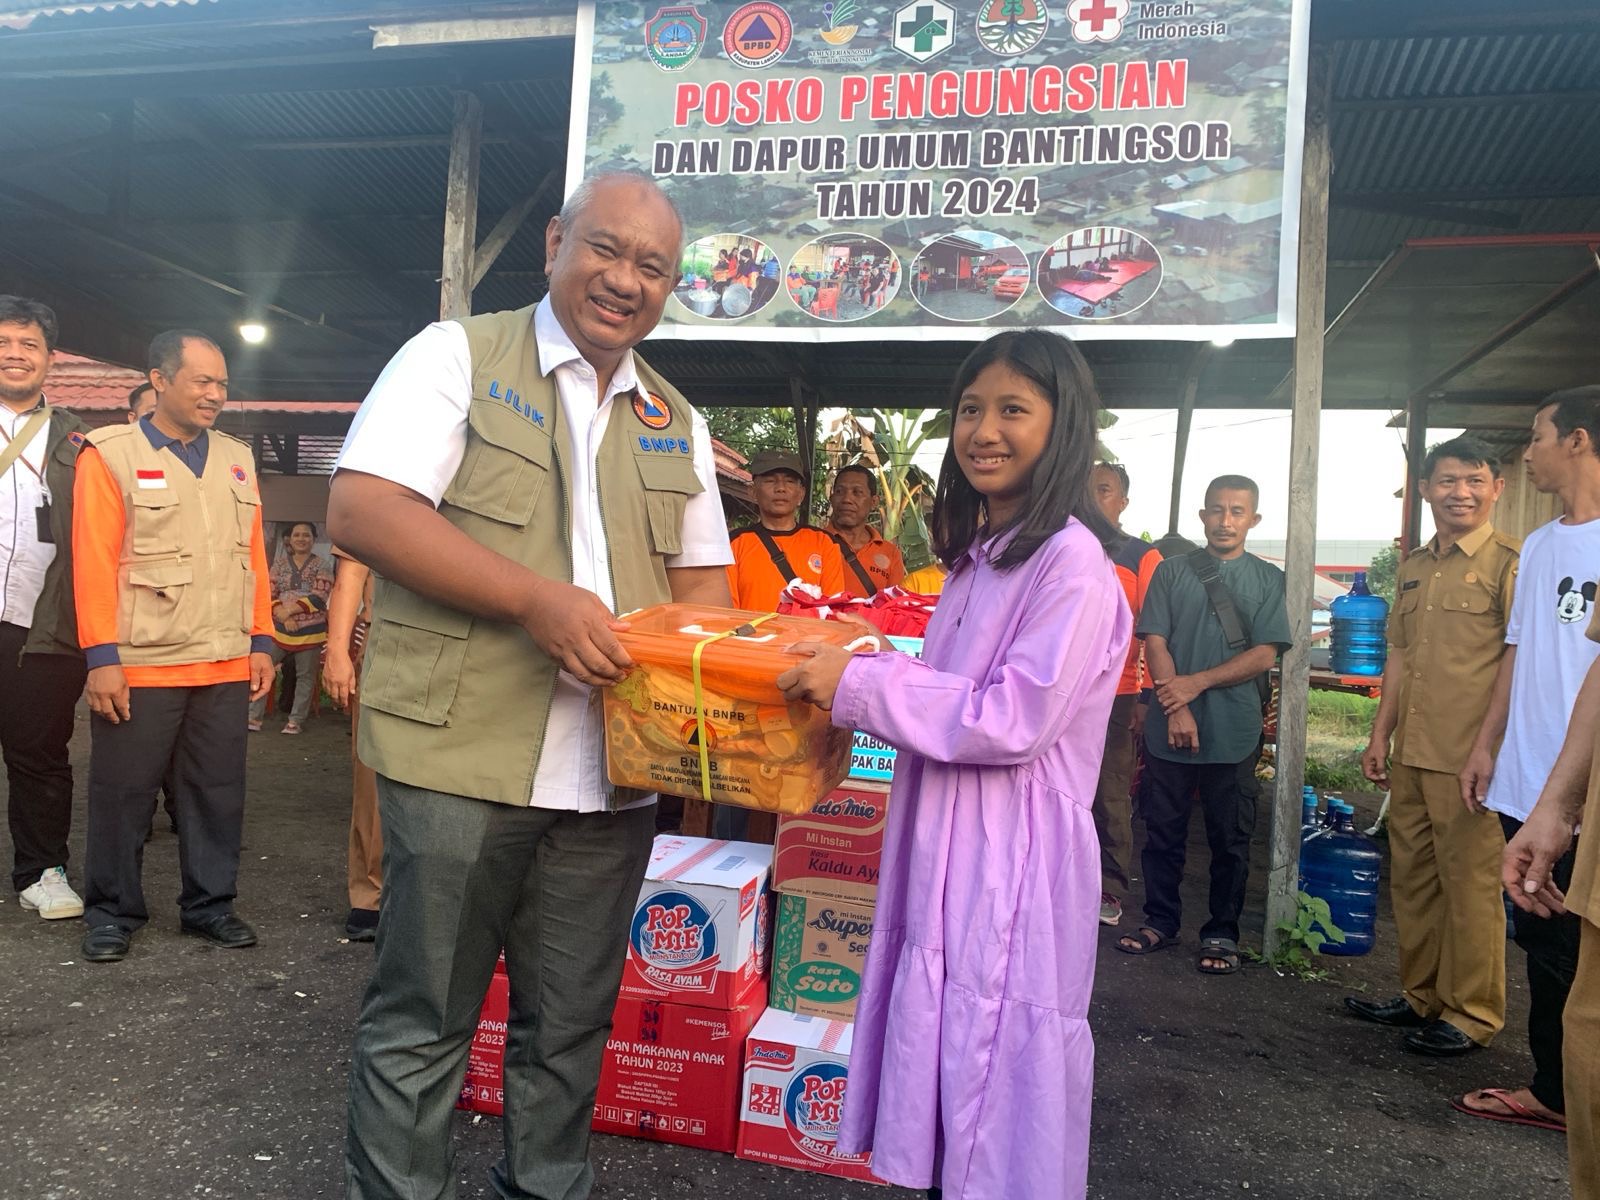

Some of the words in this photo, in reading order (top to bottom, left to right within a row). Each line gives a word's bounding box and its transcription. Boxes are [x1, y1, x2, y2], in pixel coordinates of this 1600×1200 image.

[1140, 0, 1194, 18] Merah
[1139, 20, 1226, 39] Indonesia
[743, 41, 772, 50] BPBD
[733, 53, 760, 66] KABUPATEN
[760, 52, 780, 65] LANDAK
[675, 78, 824, 126] POSKO
[840, 59, 1188, 121] PENGUNGSIAN
[653, 141, 720, 174] DAN
[731, 137, 847, 173] DAPUR
[858, 131, 971, 171] UMUM
[981, 122, 1232, 167] BANTINGSOR
[816, 181, 932, 219] TAHUN
[943, 178, 1040, 217] 2024
[489, 380, 545, 428] LILIK
[638, 435, 690, 454] BNPB
[713, 709, 745, 721] BNPB
[680, 757, 718, 771] BNB
[851, 755, 873, 769] PAK
[651, 772, 673, 782] TIDAK
[806, 832, 818, 842] Mi
[820, 835, 852, 848] Instan
[809, 858, 853, 875] Kaldu
[646, 905, 691, 931] POP
[652, 925, 699, 952] MIE
[645, 966, 672, 983] RASA
[673, 975, 702, 985] AYAM
[808, 965, 841, 976] Rasa
[794, 975, 854, 994] Soto
[480, 1033, 504, 1045] 2023
[632, 1043, 690, 1061] MAKANAN
[693, 1051, 725, 1065] ANAK
[615, 1053, 653, 1069] TAHUN
[656, 1060, 684, 1073] 2023
[751, 1085, 780, 1094] ISI
[750, 1091, 780, 1109] 24
[750, 1105, 779, 1115] CUP
[744, 1149, 760, 1157] BPOM
[800, 1137, 830, 1154] RASA
